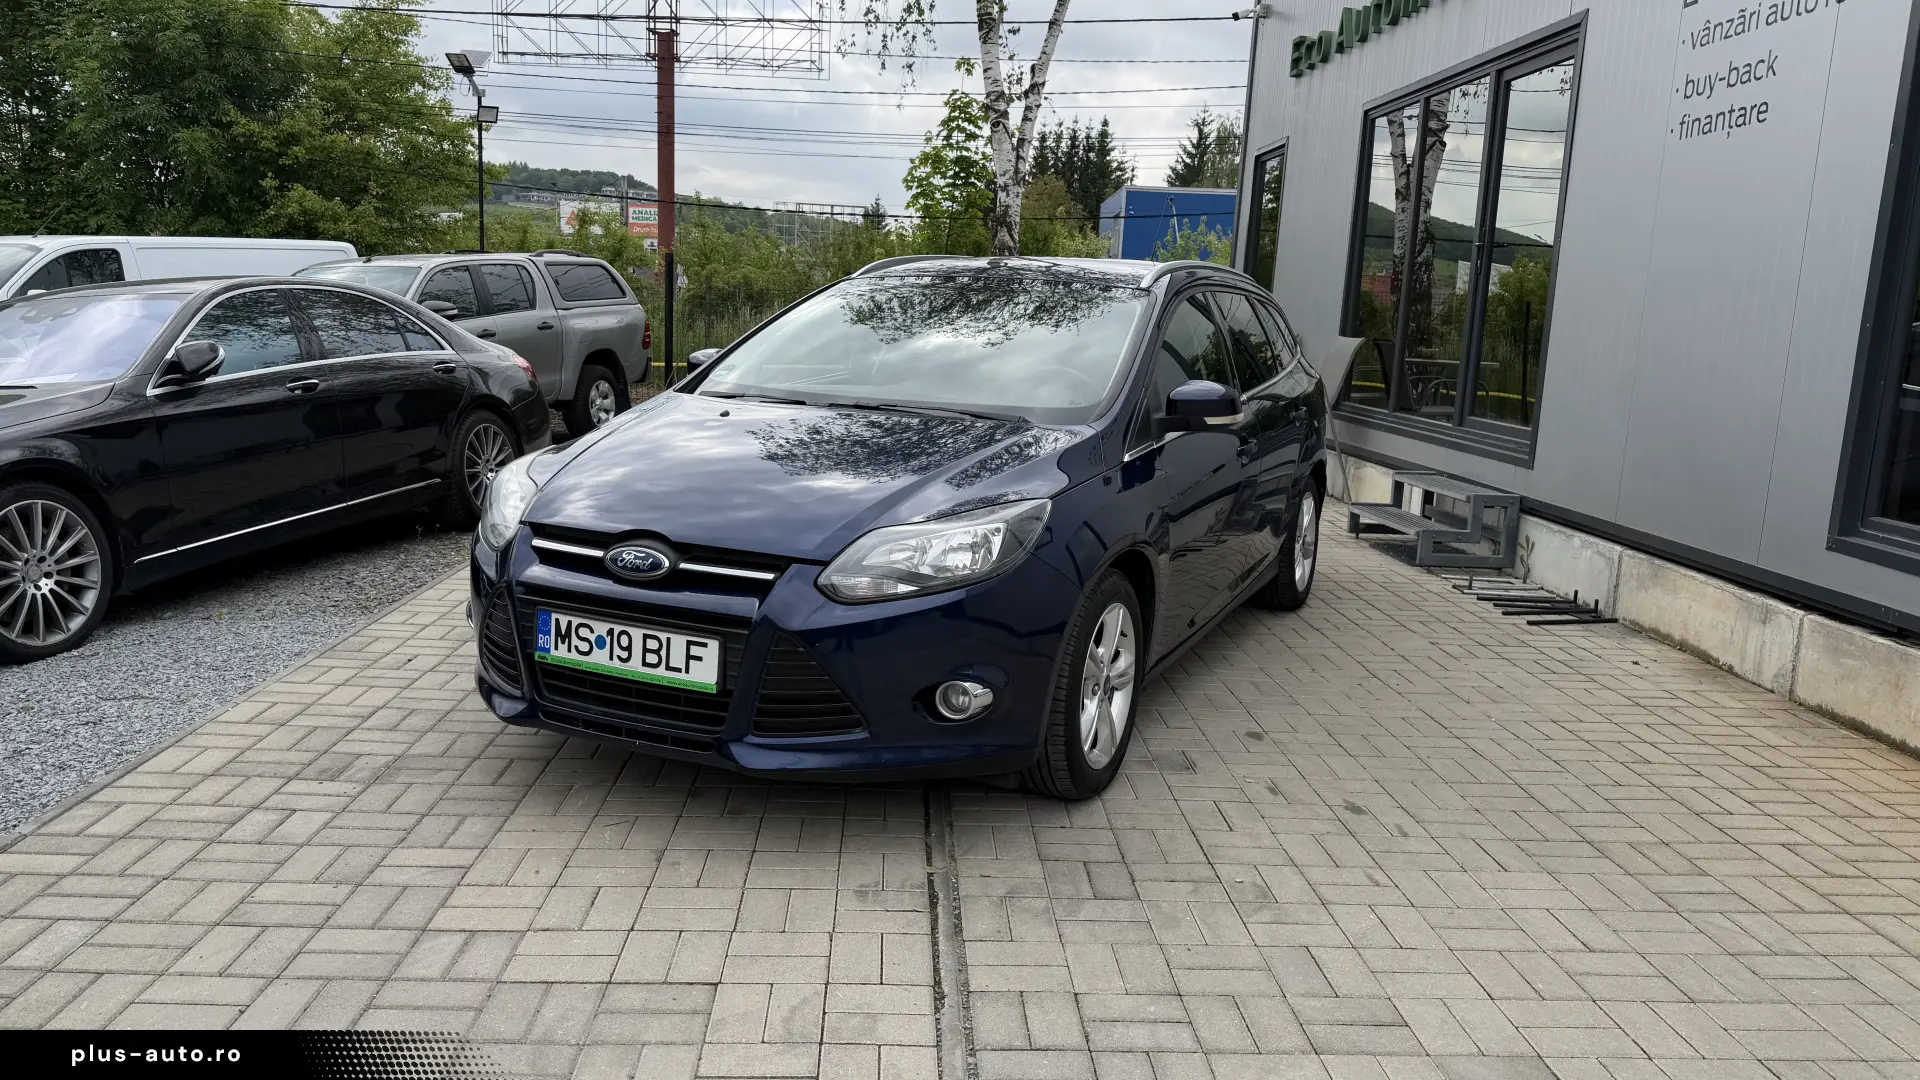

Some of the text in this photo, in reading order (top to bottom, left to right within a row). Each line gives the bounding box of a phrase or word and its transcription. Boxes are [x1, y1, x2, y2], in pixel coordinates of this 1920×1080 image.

[1683, 49, 1778, 100] buy-back
[1679, 101, 1769, 140] finanțare
[617, 551, 653, 570] Ford
[538, 634, 550, 648] RO
[554, 617, 709, 674] MS 19 BLF
